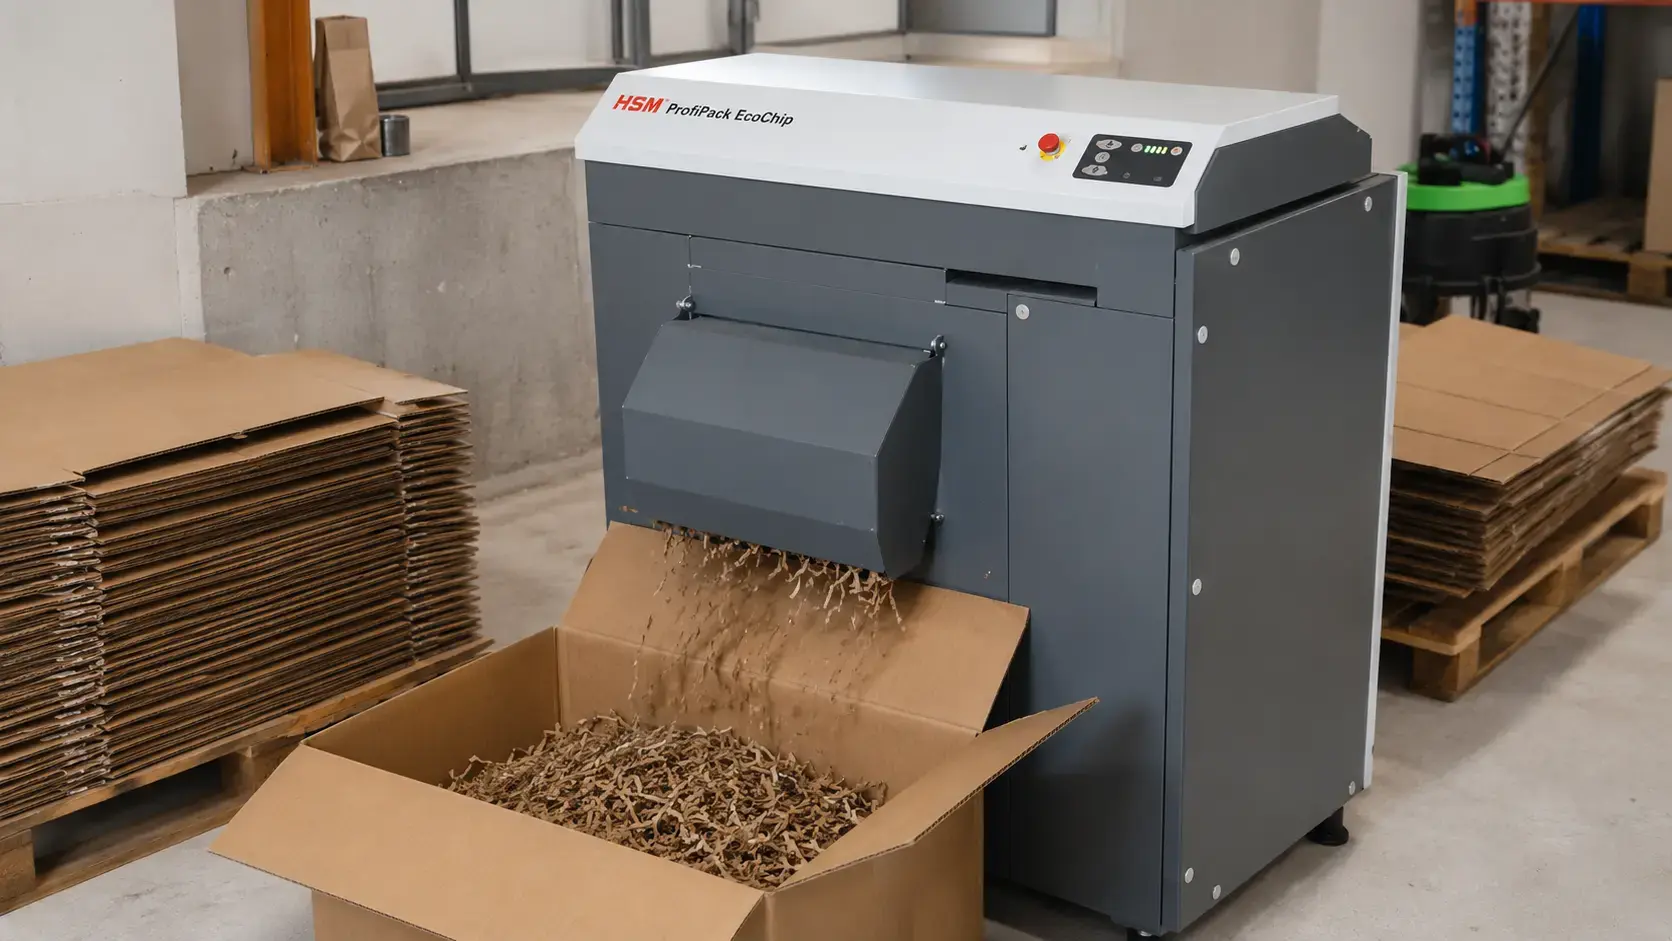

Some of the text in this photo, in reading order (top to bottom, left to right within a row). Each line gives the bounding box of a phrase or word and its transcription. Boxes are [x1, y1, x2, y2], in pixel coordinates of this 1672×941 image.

[612, 94, 794, 128] HSM ProfiPack EcoChip
